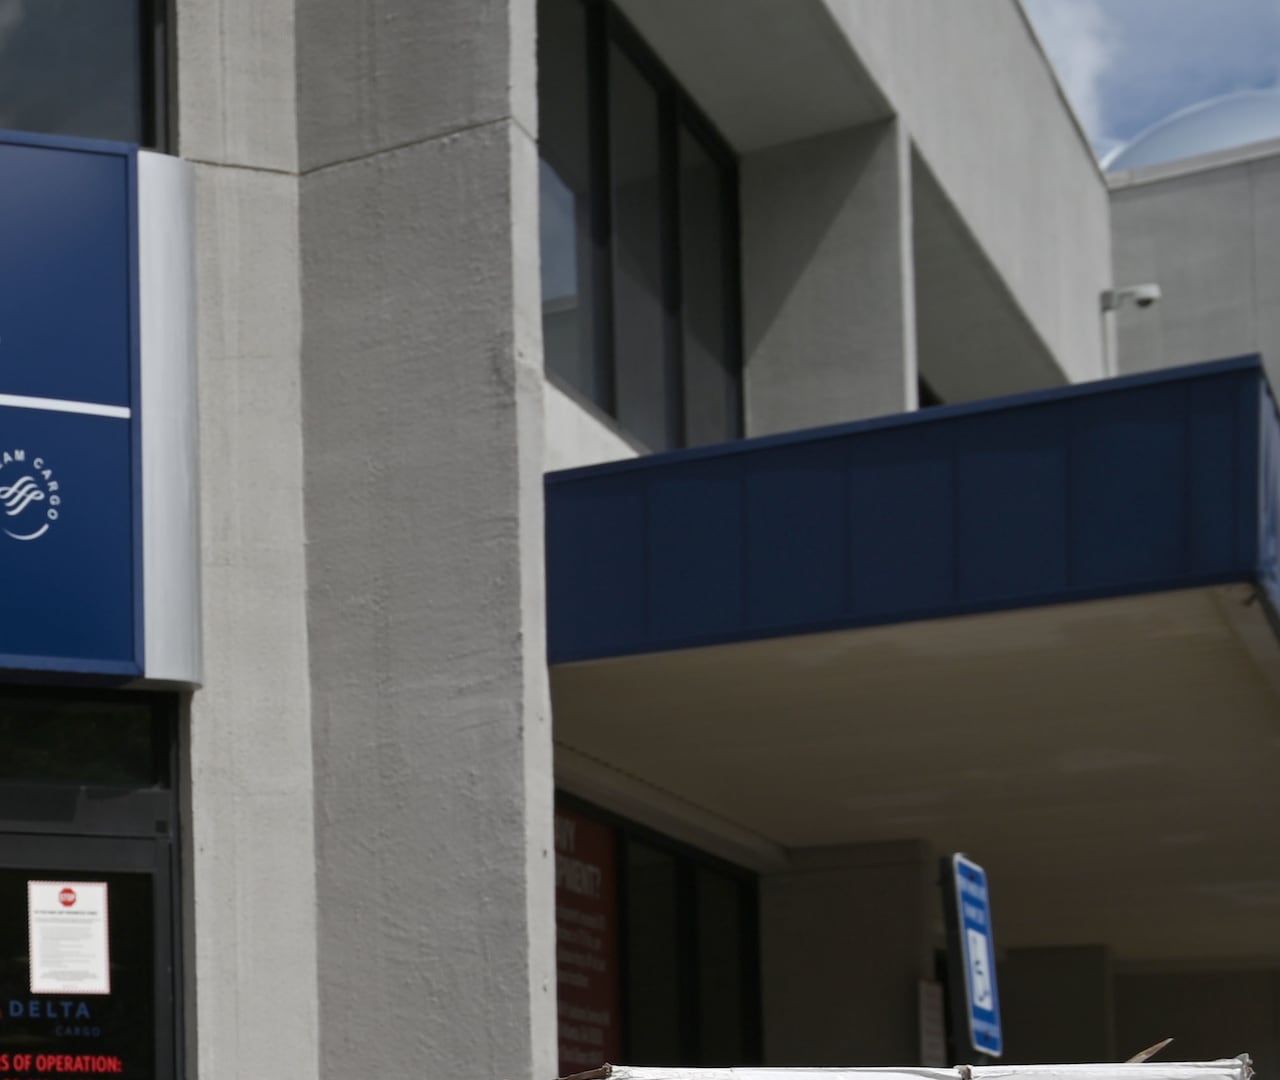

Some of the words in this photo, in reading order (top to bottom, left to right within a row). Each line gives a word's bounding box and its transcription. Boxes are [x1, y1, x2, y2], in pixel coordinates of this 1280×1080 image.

[33, 457, 61, 520] CARGO
[9, 1000, 90, 1018] DELTA
[55, 1026, 101, 1037] CARGO
[13, 1055, 32, 1071] OF
[36, 1055, 122, 1073] OPERATION:
